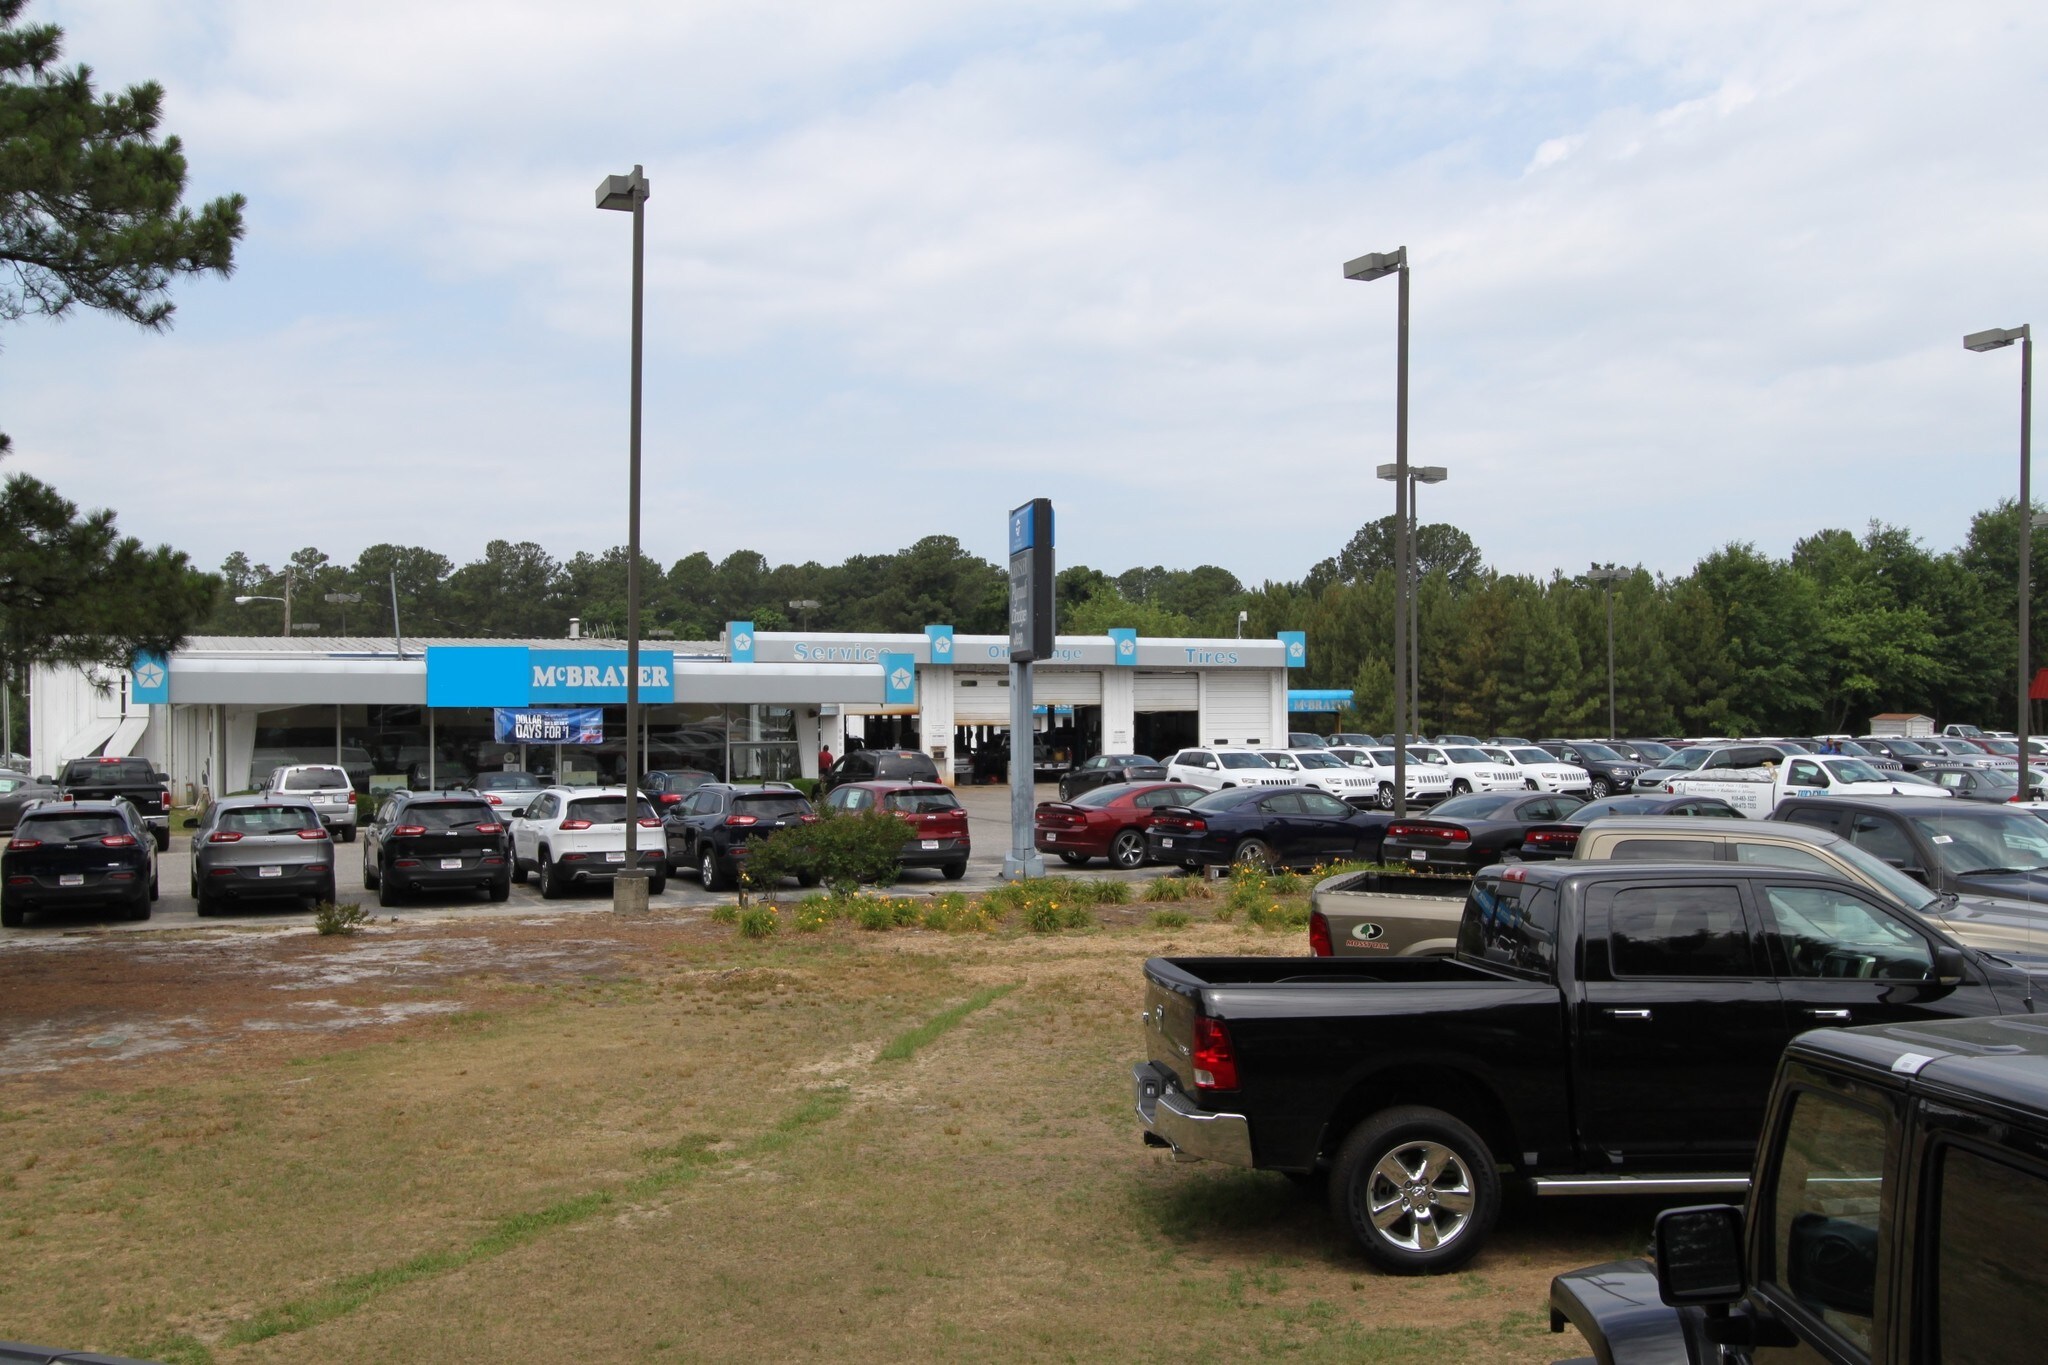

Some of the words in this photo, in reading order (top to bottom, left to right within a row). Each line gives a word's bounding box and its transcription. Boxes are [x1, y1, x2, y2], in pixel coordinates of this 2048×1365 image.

[1011, 608, 1028, 628] Dodge
[1013, 629, 1024, 648] Jeep
[1184, 647, 1239, 665] Tires
[515, 714, 542, 724] DOLLAR
[515, 724, 542, 739] DAYS
[544, 725, 562, 739] FOR
